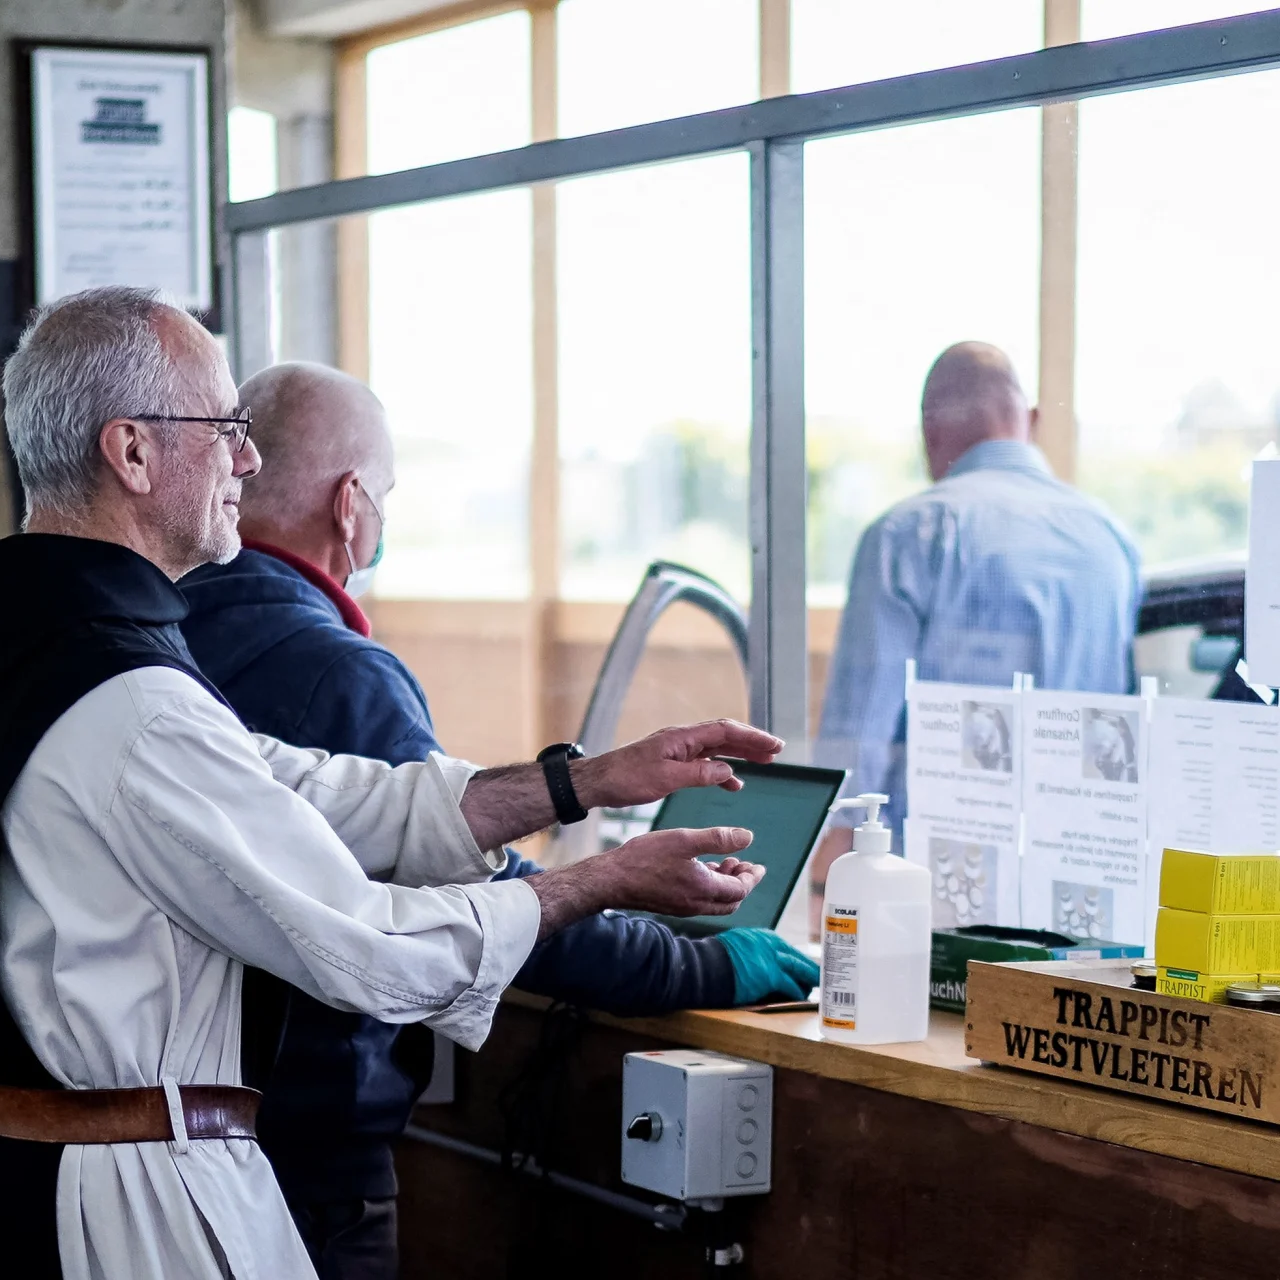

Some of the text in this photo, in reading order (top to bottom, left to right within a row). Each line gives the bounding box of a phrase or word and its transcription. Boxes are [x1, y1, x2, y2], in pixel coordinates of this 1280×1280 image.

[1053, 987, 1209, 1051] TRAPPIST
[1159, 979, 1207, 998] TRAPPIST
[1001, 1022, 1263, 1109] WESTVLETEREN
